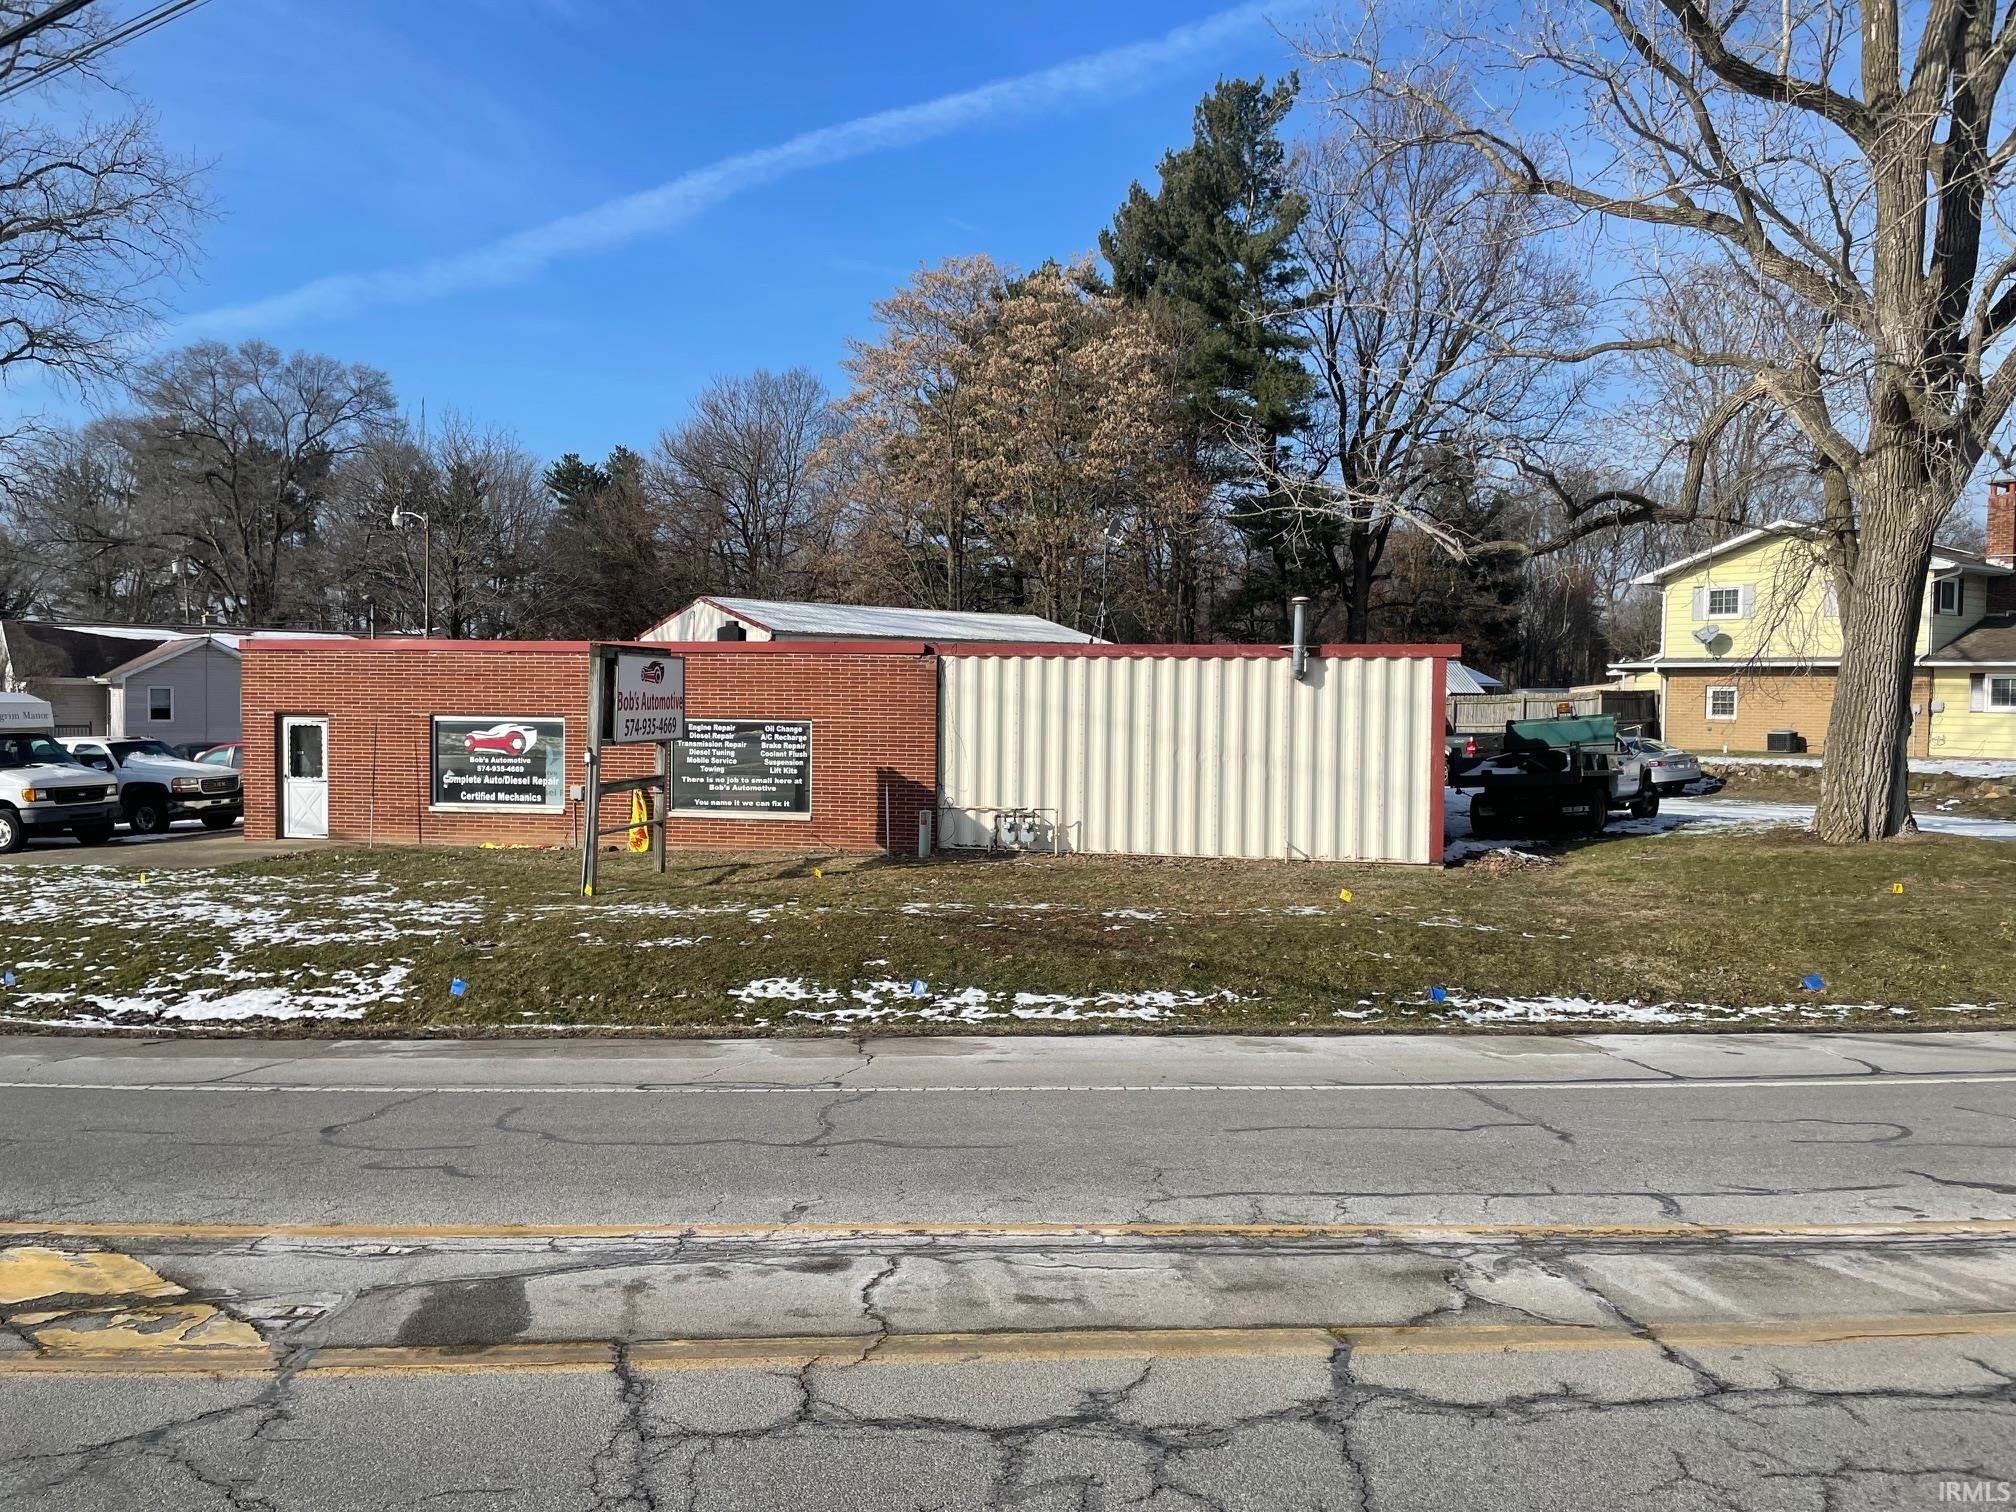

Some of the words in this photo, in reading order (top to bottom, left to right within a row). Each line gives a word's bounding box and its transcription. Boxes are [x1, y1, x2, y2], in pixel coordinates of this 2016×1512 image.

[618, 691, 639, 711] Bob's
[642, 691, 683, 710] Automotive
[625, 717, 676, 736] 574-935-4669
[764, 759, 803, 767] Suspension
[443, 775, 482, 785] Complete
[483, 776, 530, 785] Auto/Diesel
[532, 777, 559, 787] Repair
[461, 791, 496, 801] Certified
[498, 793, 542, 802] Mechanics
